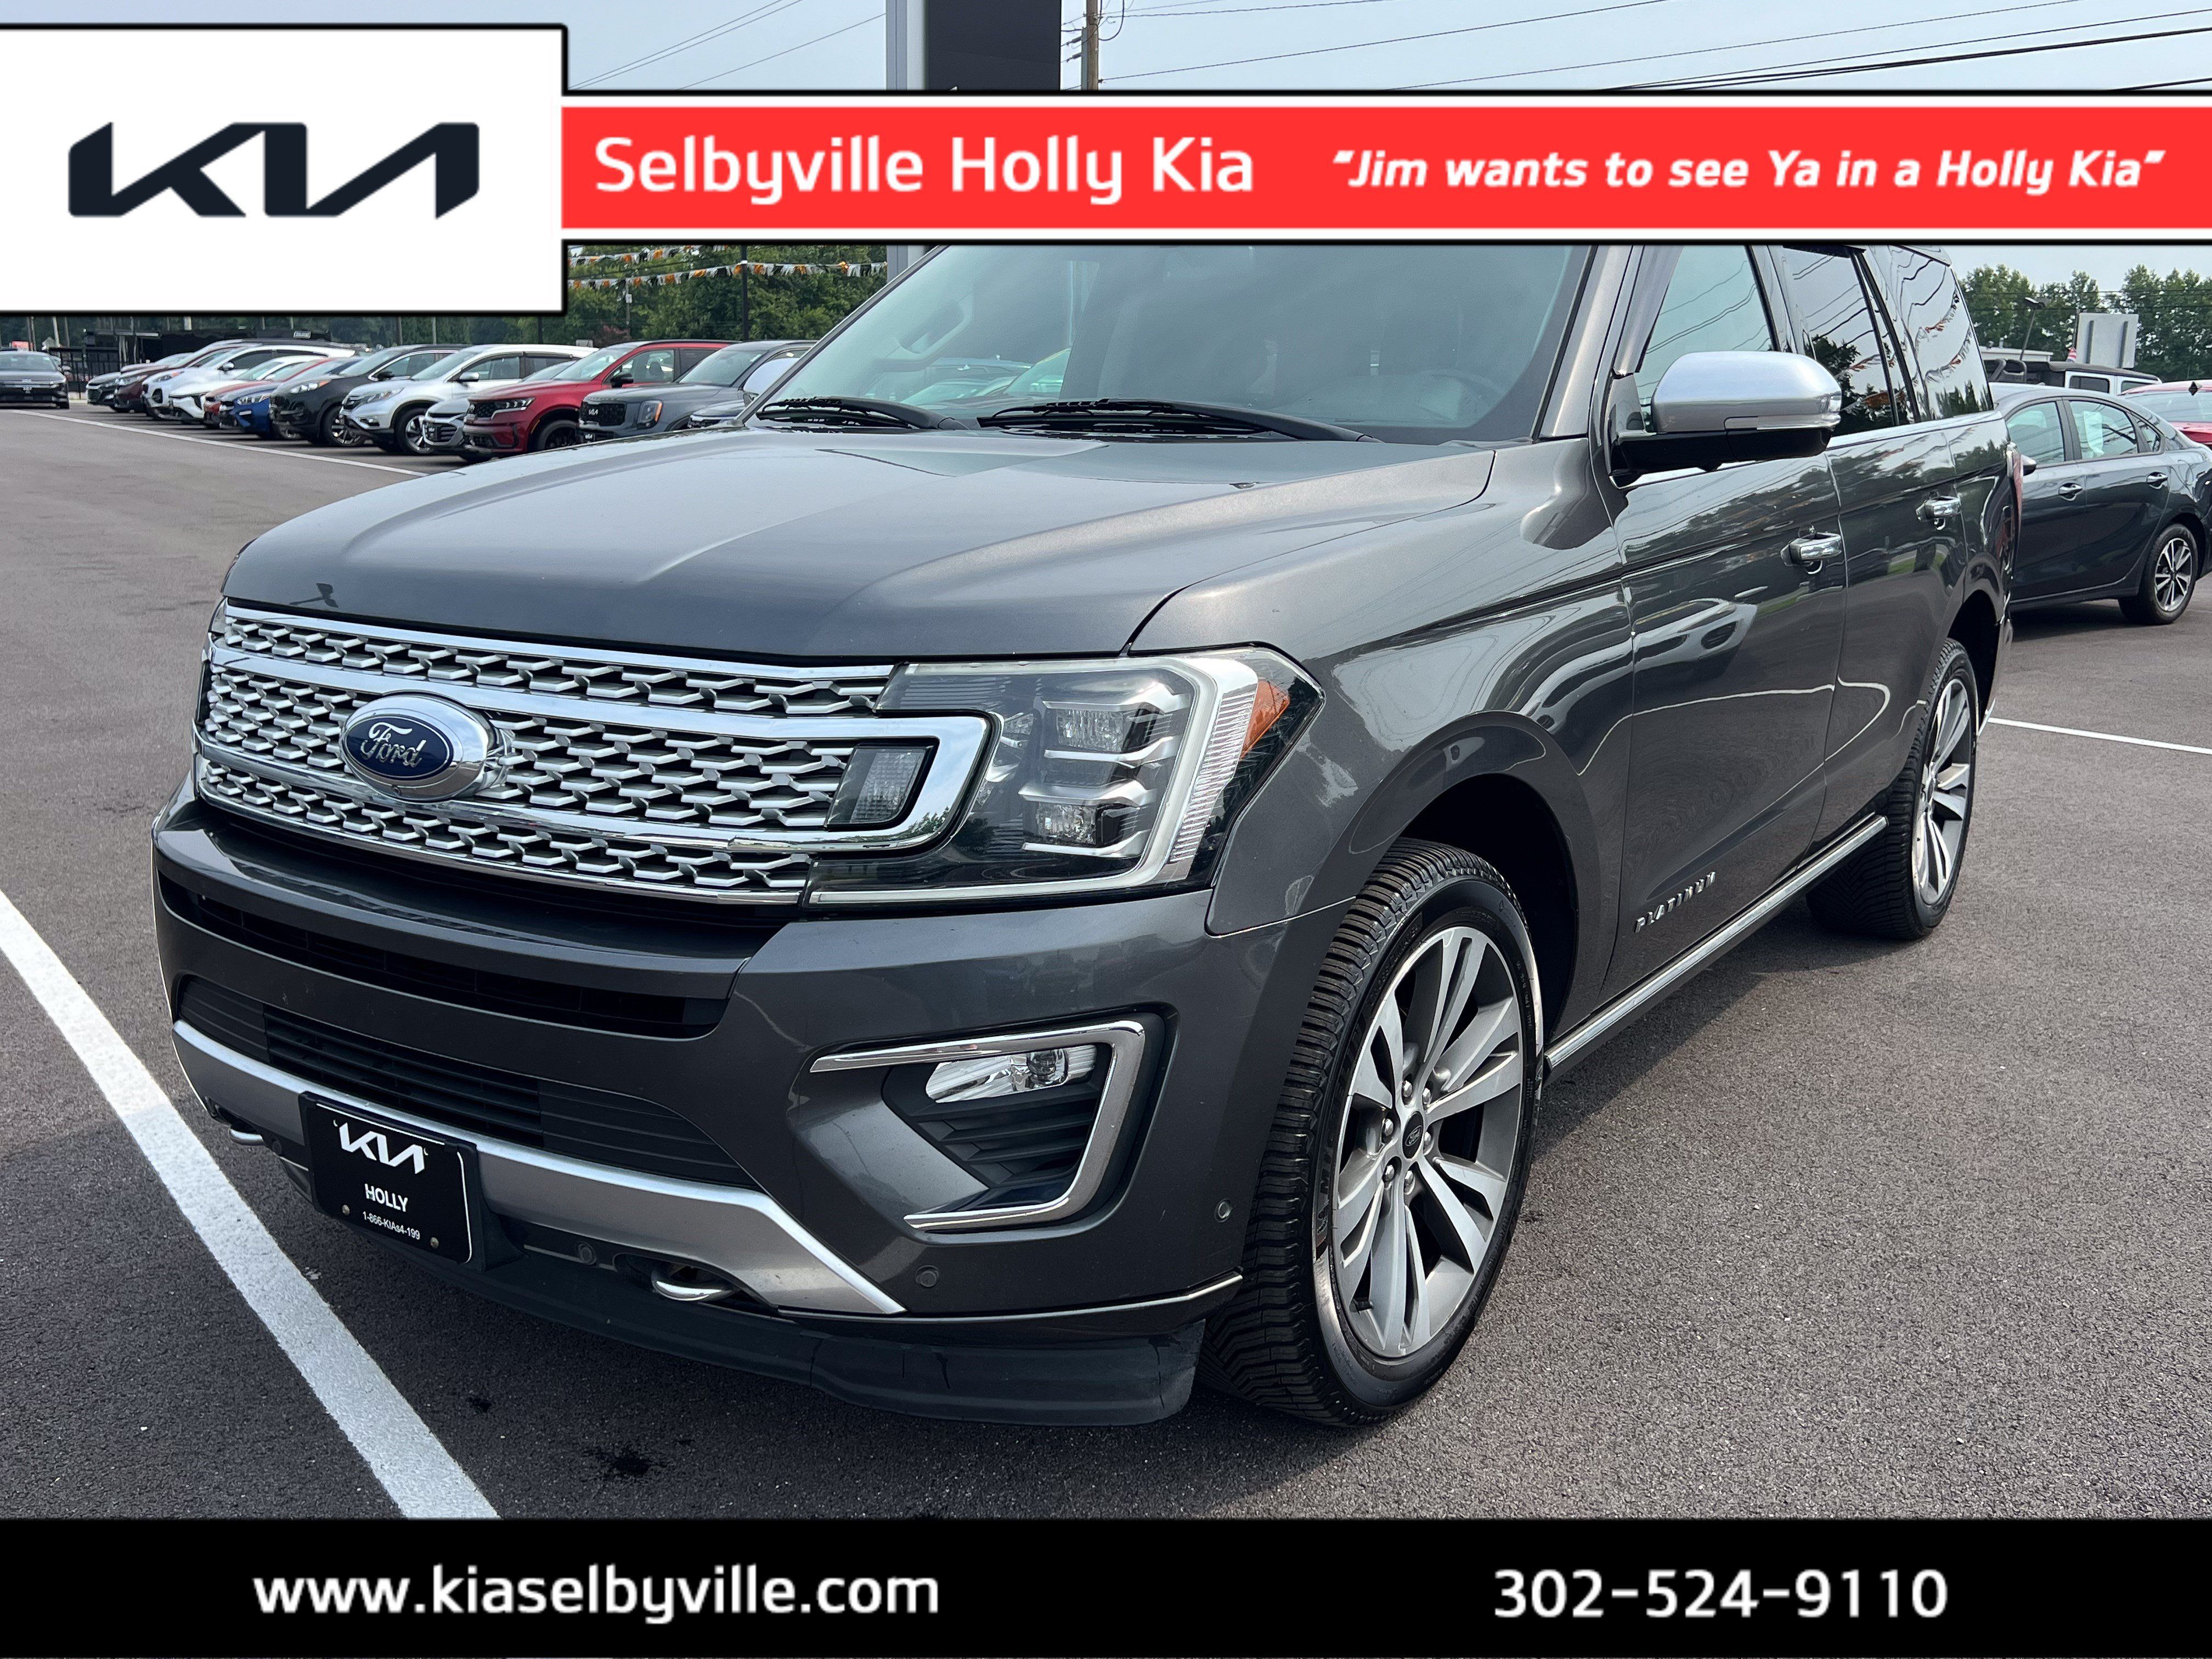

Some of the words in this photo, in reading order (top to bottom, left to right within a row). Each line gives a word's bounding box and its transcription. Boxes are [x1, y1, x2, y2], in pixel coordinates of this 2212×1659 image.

[360, 721, 426, 768] Ford
[1634, 871, 1716, 933] PLATINUM
[338, 1122, 425, 1175] KIA
[364, 1183, 408, 1212] HOLLY
